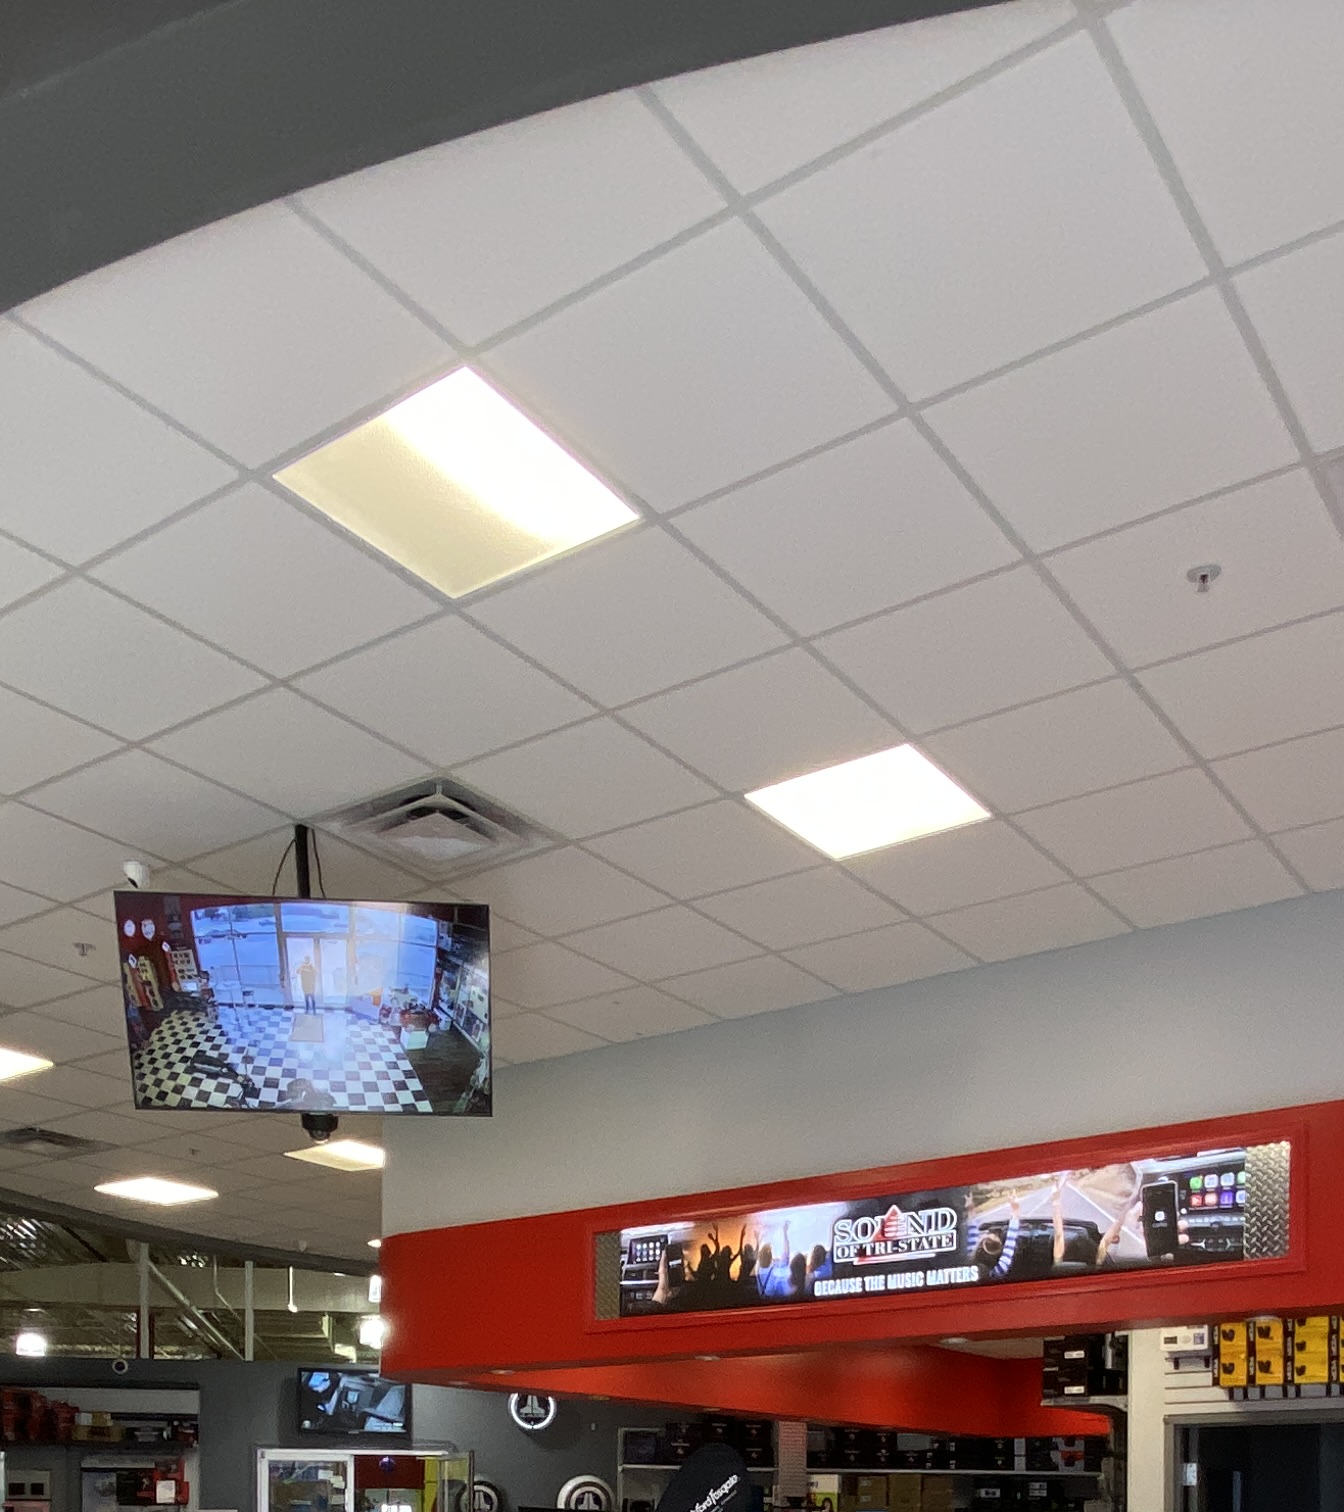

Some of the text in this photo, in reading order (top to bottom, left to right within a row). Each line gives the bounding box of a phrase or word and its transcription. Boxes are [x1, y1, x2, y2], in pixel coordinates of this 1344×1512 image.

[834, 1207, 957, 1242] SOUND
[837, 1235, 953, 1258] OF TRI-STATE
[814, 1266, 979, 1296] BECAUSE THE MUSIC MATTERS
